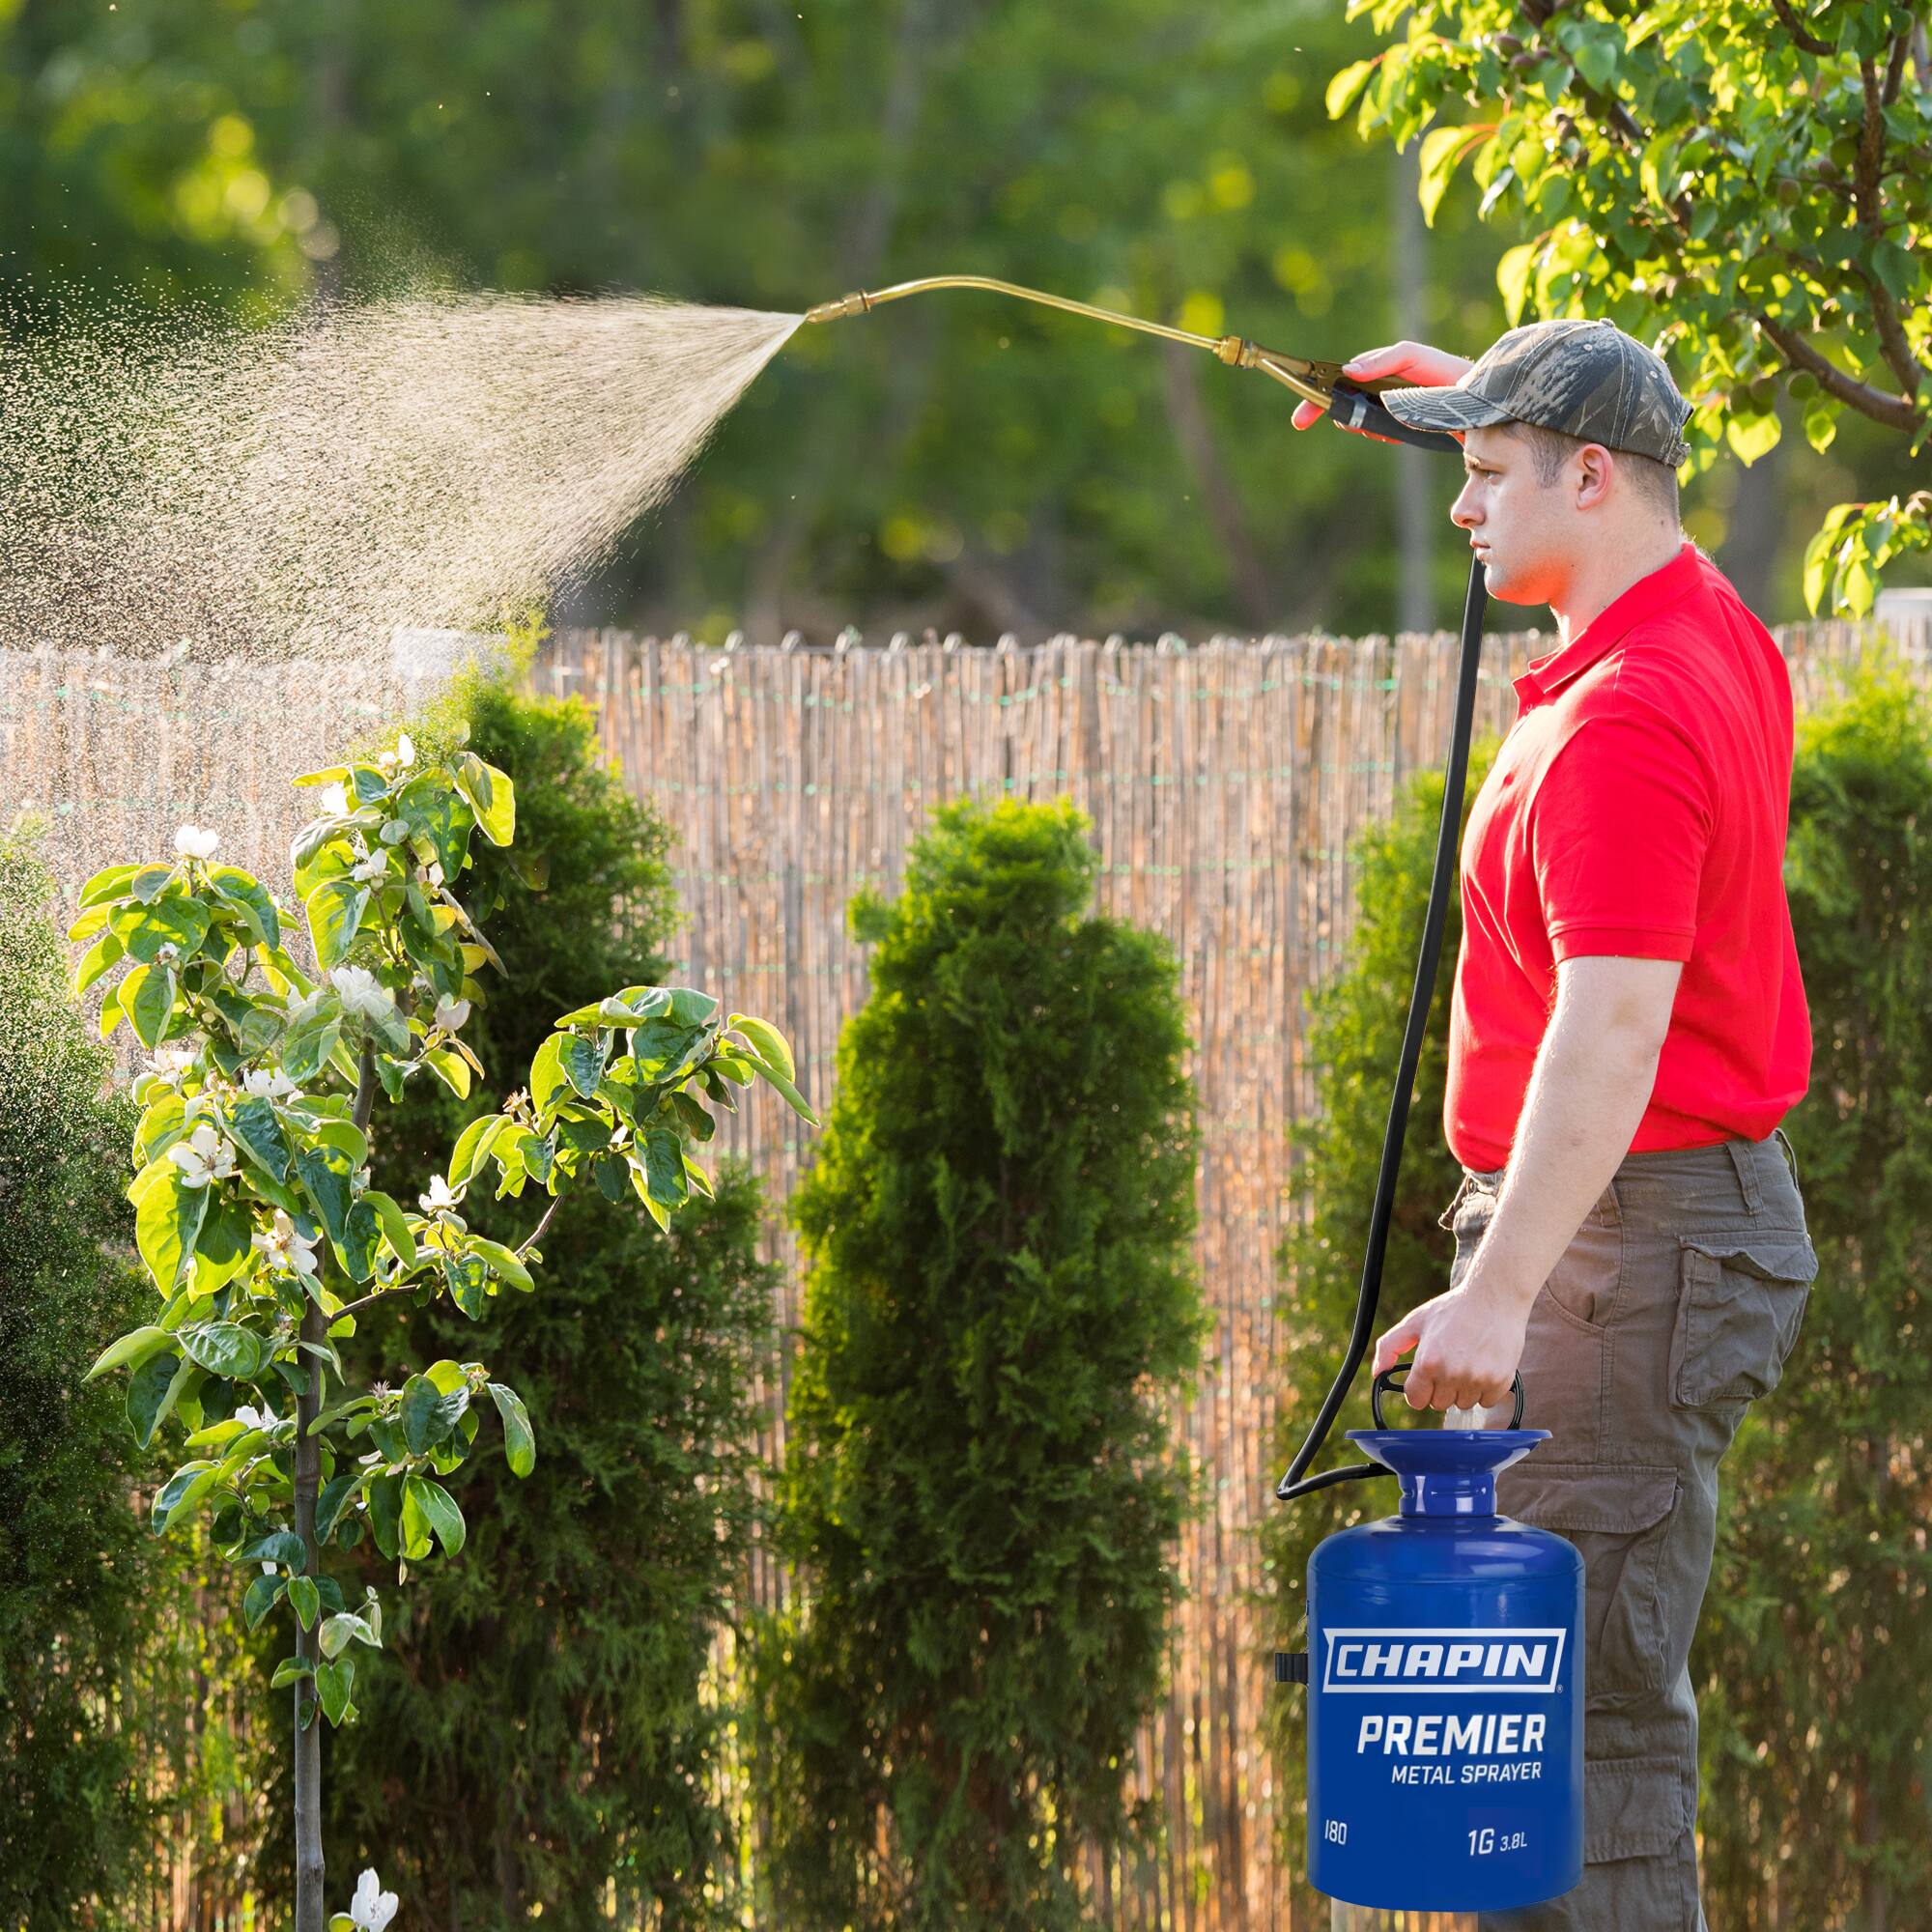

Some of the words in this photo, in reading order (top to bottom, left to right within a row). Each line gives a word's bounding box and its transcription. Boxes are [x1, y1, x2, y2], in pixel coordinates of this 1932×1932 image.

[1337, 1644, 1548, 1677] CHAPIN
[1357, 1714, 1547, 1755] PREMIER
[1391, 1765, 1455, 1785] METAL
[1460, 1761, 1542, 1784] SPRAYER
[1467, 1828, 1495, 1857] 1G
[1499, 1832, 1528, 1852] 3.8L
